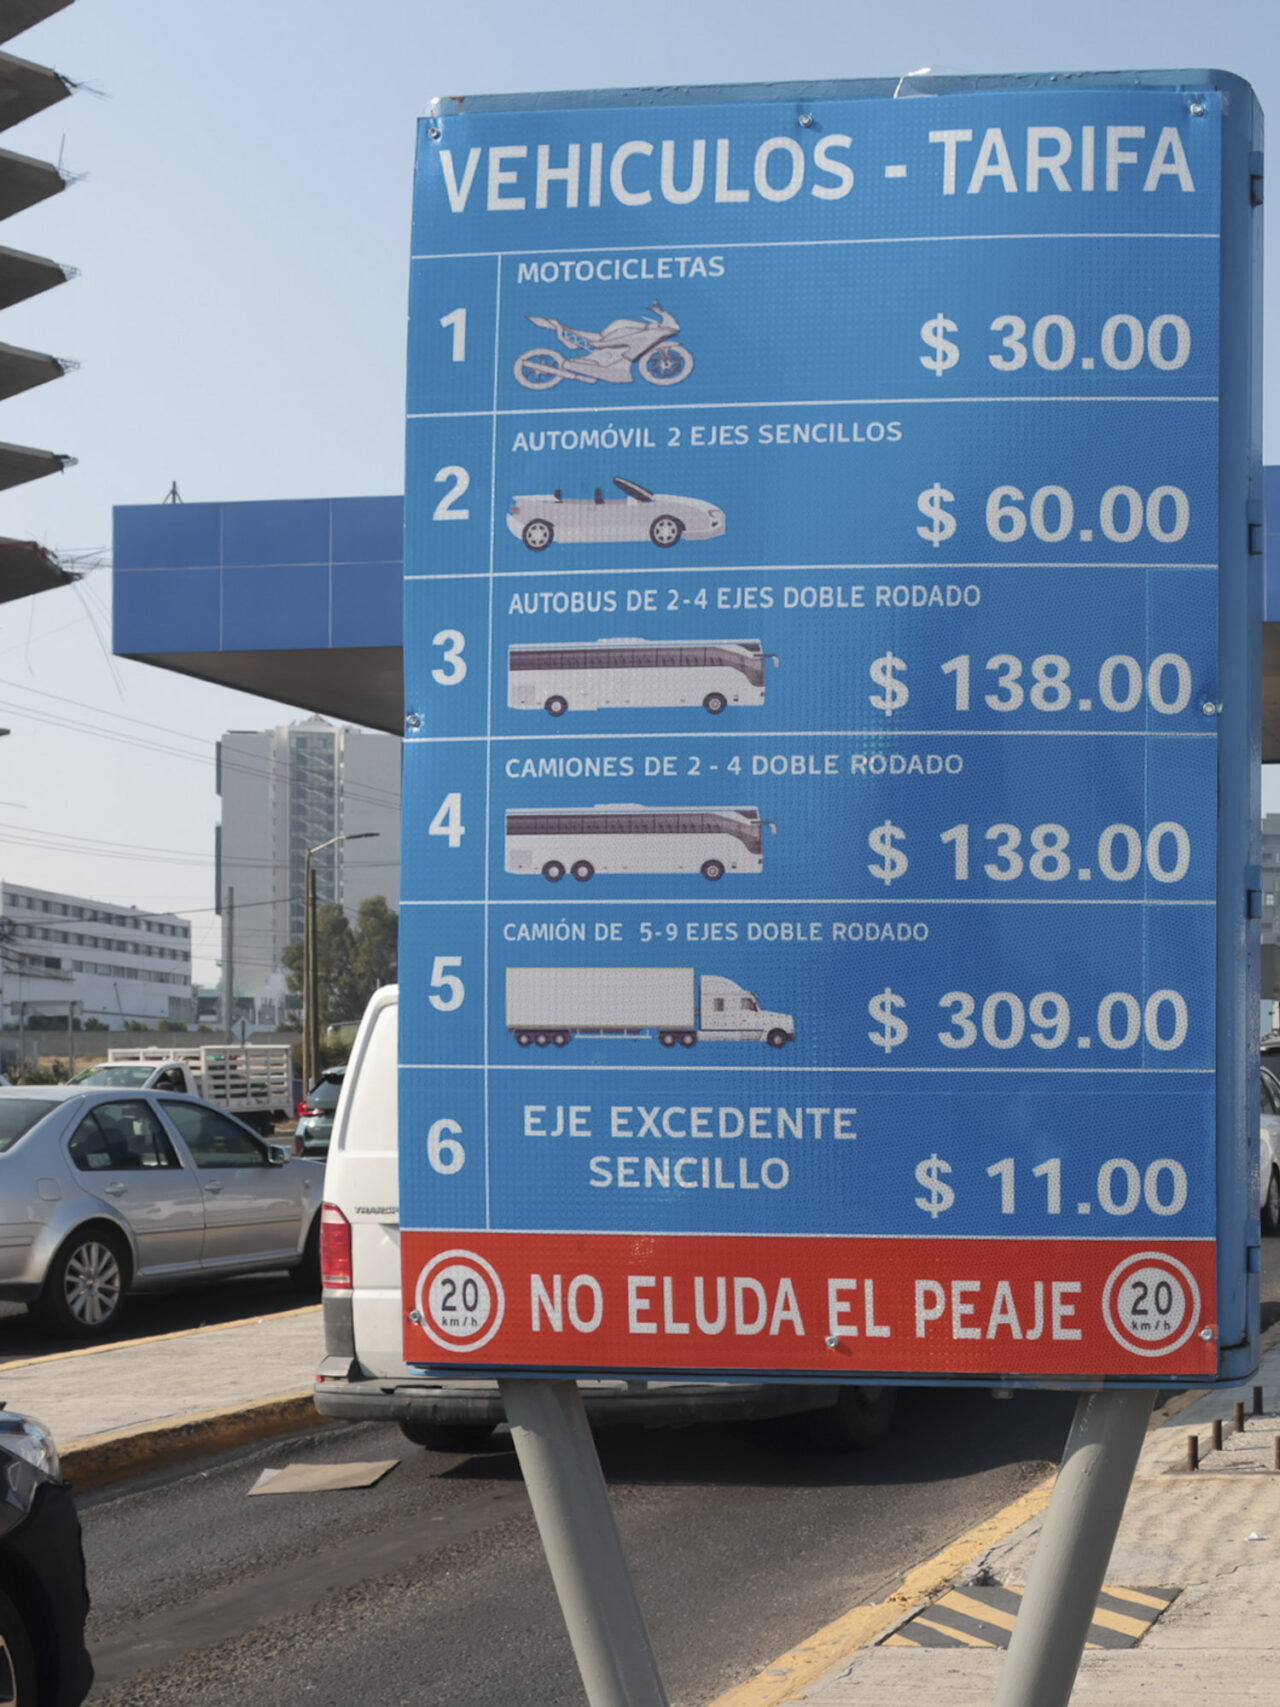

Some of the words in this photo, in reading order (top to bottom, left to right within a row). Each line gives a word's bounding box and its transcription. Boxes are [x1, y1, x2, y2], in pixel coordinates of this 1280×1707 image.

[439, 133, 856, 213] VEHICULOS
[885, 164, 907, 178] -
[928, 126, 1195, 195] TARIFA
[516, 255, 727, 284] MOTOCICLETAS
[440, 308, 467, 362] 1
[920, 313, 960, 377] $
[988, 314, 1191, 372] 30.00
[512, 424, 656, 452] AUTOMÓVIL
[667, 427, 681, 447] 2
[690, 424, 750, 446] EJES
[758, 421, 903, 445] SENCILLOS
[433, 465, 470, 521] 2
[916, 482, 957, 547] $
[985, 485, 1190, 543] 60.00
[508, 589, 617, 615] AUTOBUS
[626, 589, 658, 612] DE
[667, 588, 708, 611] 2-4
[717, 585, 775, 609] EJES
[783, 585, 865, 609] DOBLE
[875, 584, 981, 608] RODADO
[431, 629, 467, 686] 3
[869, 651, 909, 717] $
[941, 652, 1193, 715] 138.00
[505, 756, 635, 779] CAMIONES
[644, 756, 678, 777] DE
[687, 755, 701, 776] 2
[727, 755, 742, 775] 4
[752, 754, 839, 776] DOBLE
[850, 753, 963, 775] RODADO
[429, 792, 466, 848] 4
[868, 820, 909, 886] $
[940, 821, 1191, 883] 138.00
[503, 918, 586, 942] CAMIÓN
[594, 922, 623, 941] DE
[639, 921, 679, 943] 5-9
[686, 922, 739, 942] EJES
[747, 922, 823, 942] DOBLE
[832, 921, 930, 942] RODADO
[429, 956, 465, 1012] 5
[868, 987, 909, 1053] $
[938, 989, 1189, 1051] 309.00
[427, 1118, 466, 1175] 6
[524, 1105, 592, 1137] EJE
[610, 1105, 857, 1140] EXCEDENTE
[589, 1155, 790, 1189] SENCILLO
[915, 1153, 955, 1219] $
[986, 1157, 1188, 1216] 11.00
[440, 1278, 479, 1312] 20
[441, 1316, 478, 1327] km/h
[530, 1273, 604, 1333] NO
[627, 1275, 806, 1336] ELUDA
[824, 1278, 892, 1339] EL
[914, 1279, 1082, 1341] PEAJE
[1131, 1281, 1173, 1315] 20
[1131, 1321, 1171, 1331] km/h
